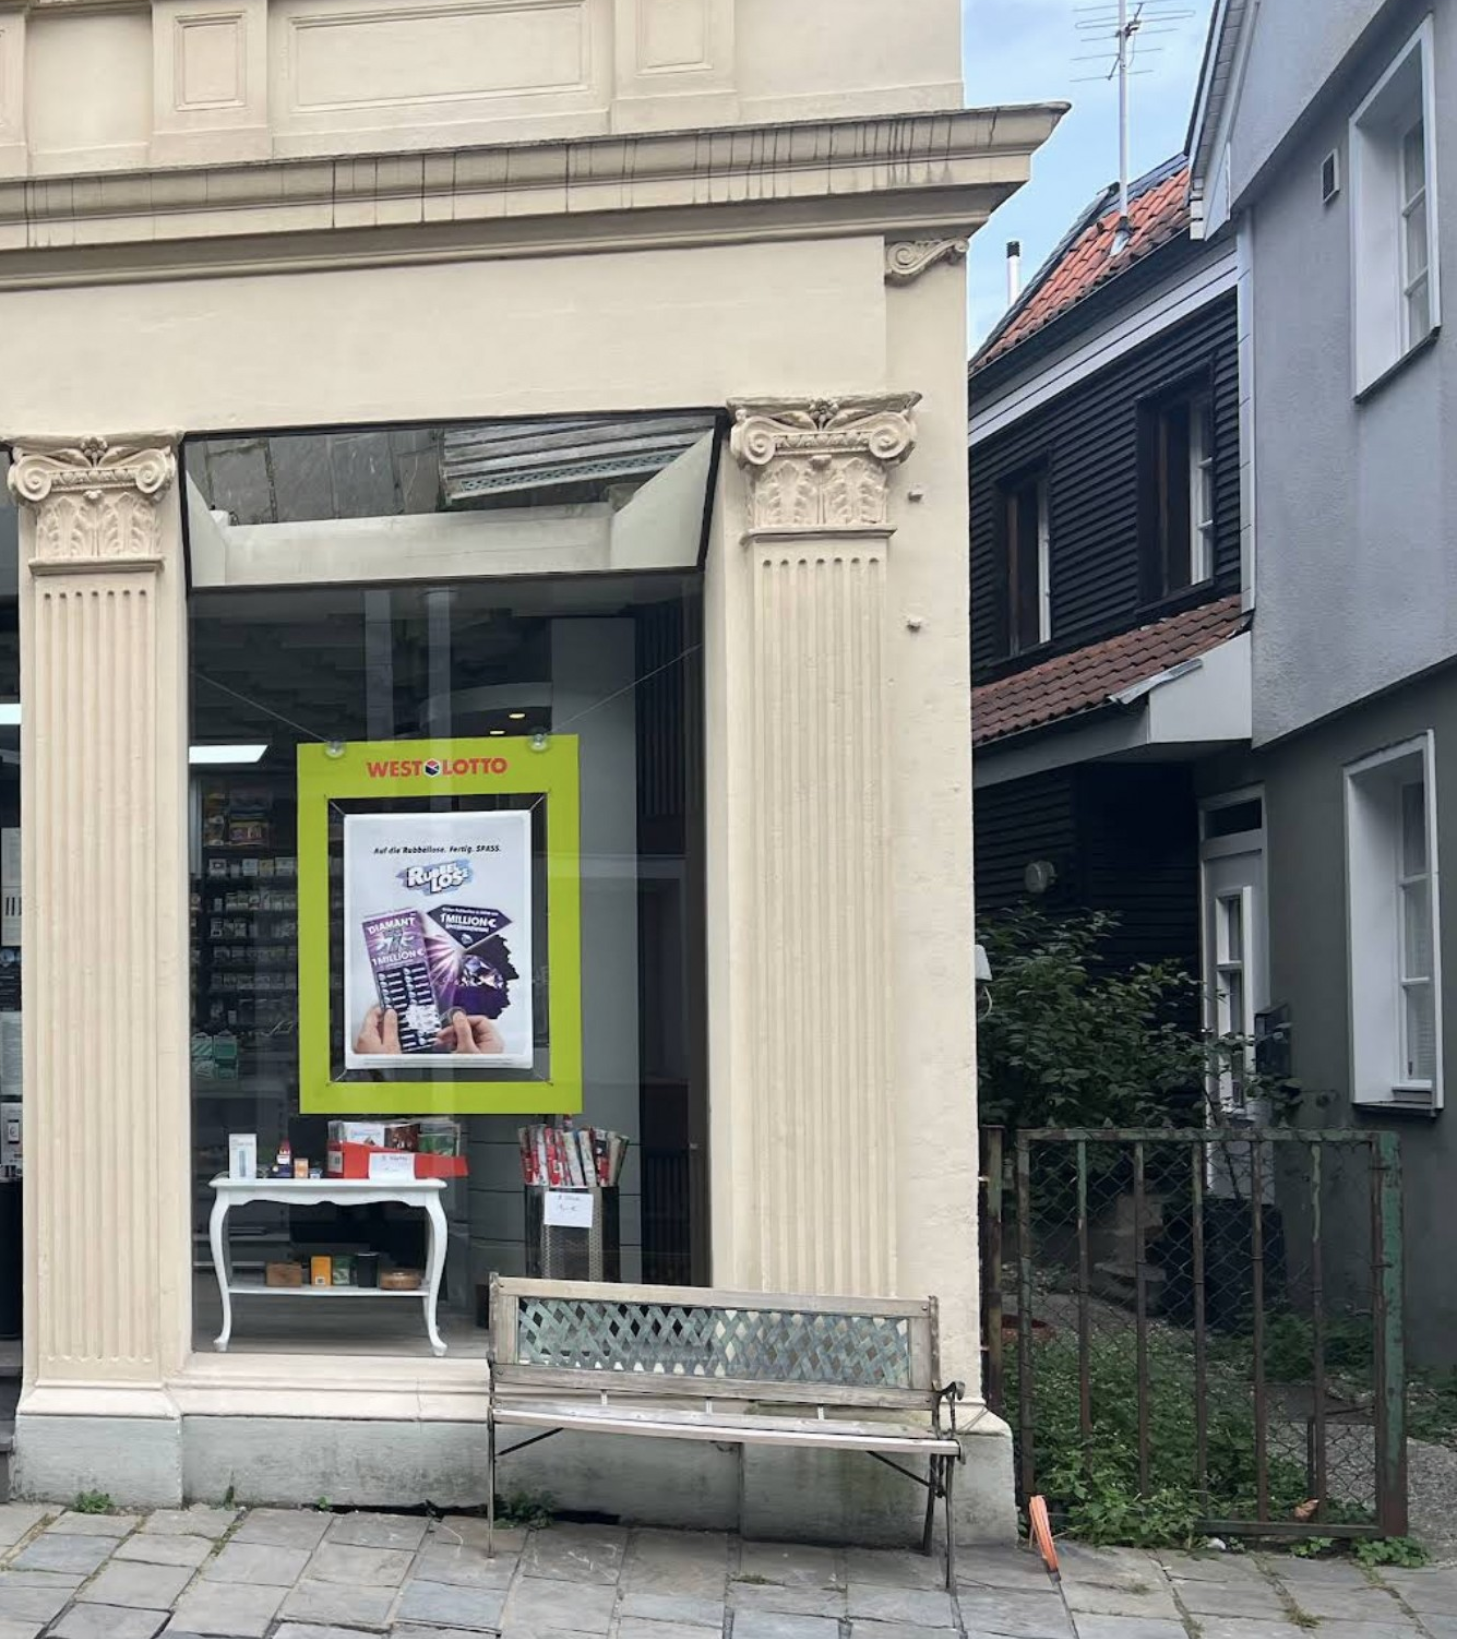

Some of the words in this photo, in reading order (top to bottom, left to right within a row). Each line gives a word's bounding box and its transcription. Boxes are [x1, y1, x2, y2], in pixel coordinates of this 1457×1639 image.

[367, 760, 422, 778] WEST
[442, 757, 508, 775] LOTTO
[367, 917, 416, 934] DIAMANT
[445, 914, 488, 927] MILLION
[377, 950, 417, 965] MILLION
